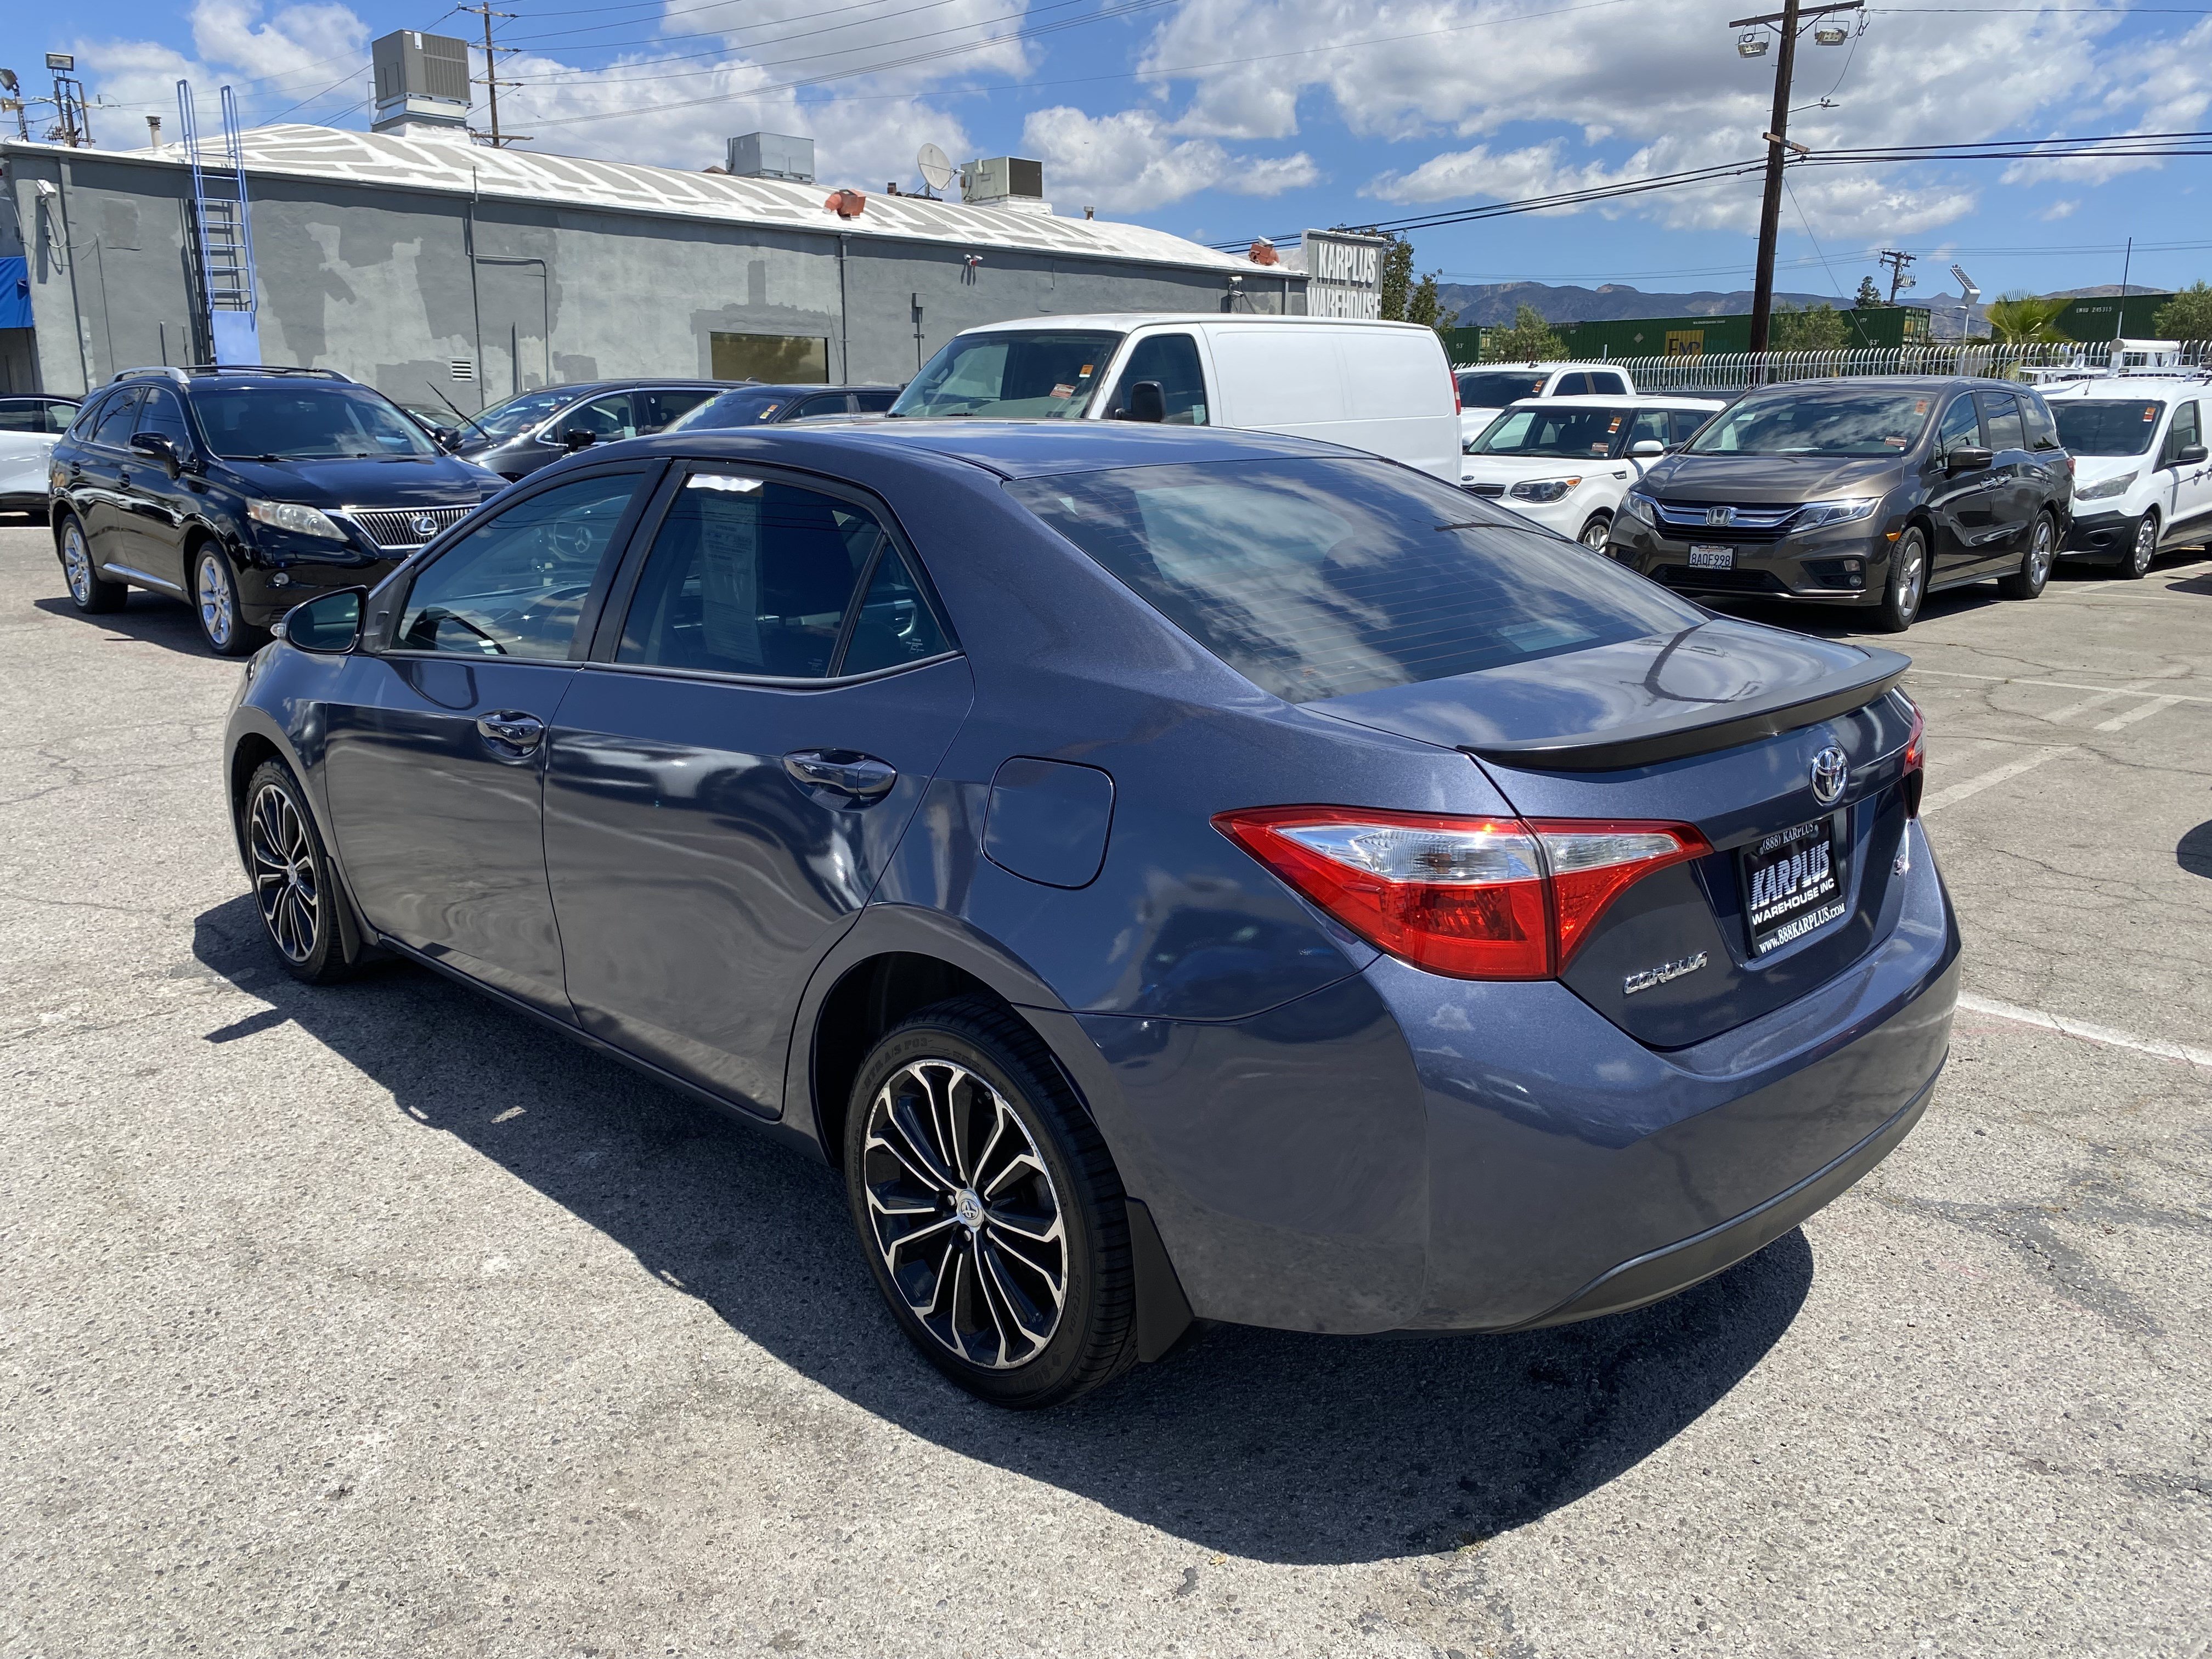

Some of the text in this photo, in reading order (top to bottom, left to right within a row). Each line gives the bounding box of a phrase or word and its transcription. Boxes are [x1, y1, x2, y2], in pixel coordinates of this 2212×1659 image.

[1318, 242, 1376, 283] KARPLUS
[1306, 286, 1381, 319] WAREHOUSE
[1763, 823, 1814, 850] (888) KARPLUS
[1751, 840, 1830, 910] KARPLUS
[1752, 878, 1835, 925] WAREHOUSE INC
[1624, 951, 1708, 994] COROLLA
